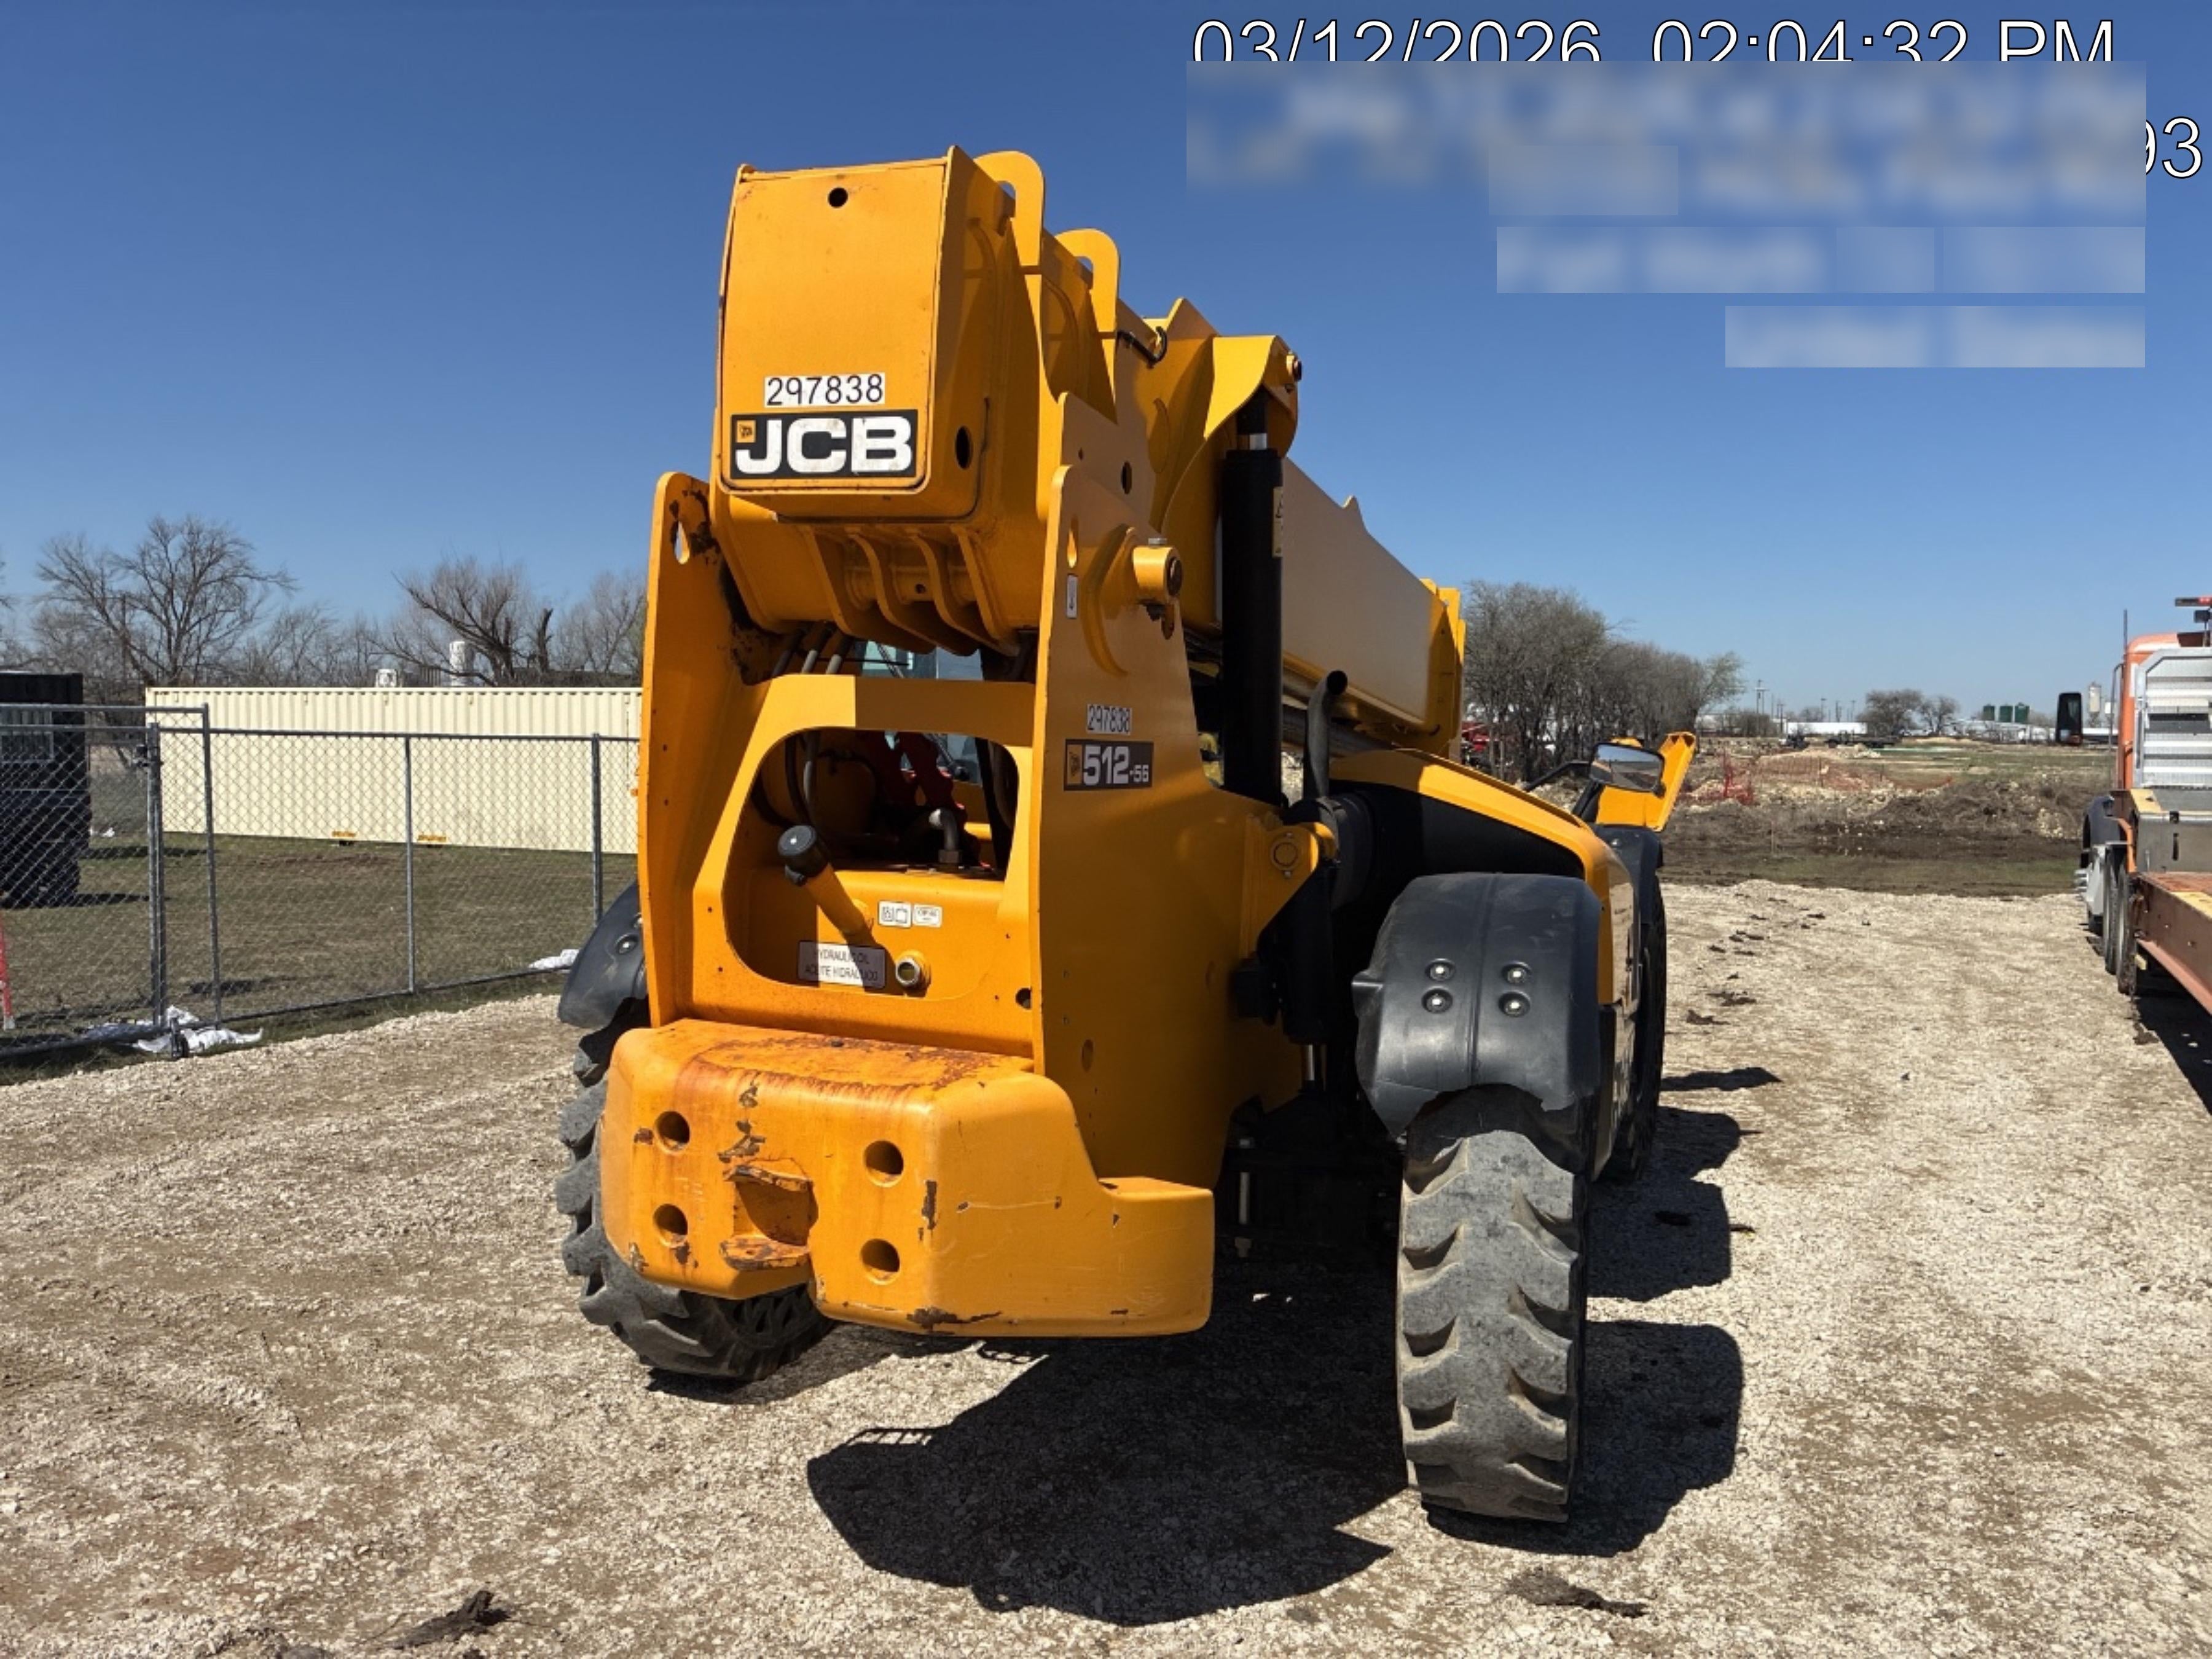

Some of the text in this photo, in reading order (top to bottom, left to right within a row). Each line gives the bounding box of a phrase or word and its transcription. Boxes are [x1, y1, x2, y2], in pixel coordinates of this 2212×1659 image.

[766, 374, 883, 406] 297838
[735, 416, 913, 474] JCB
[1087, 705, 1131, 732] 297838
